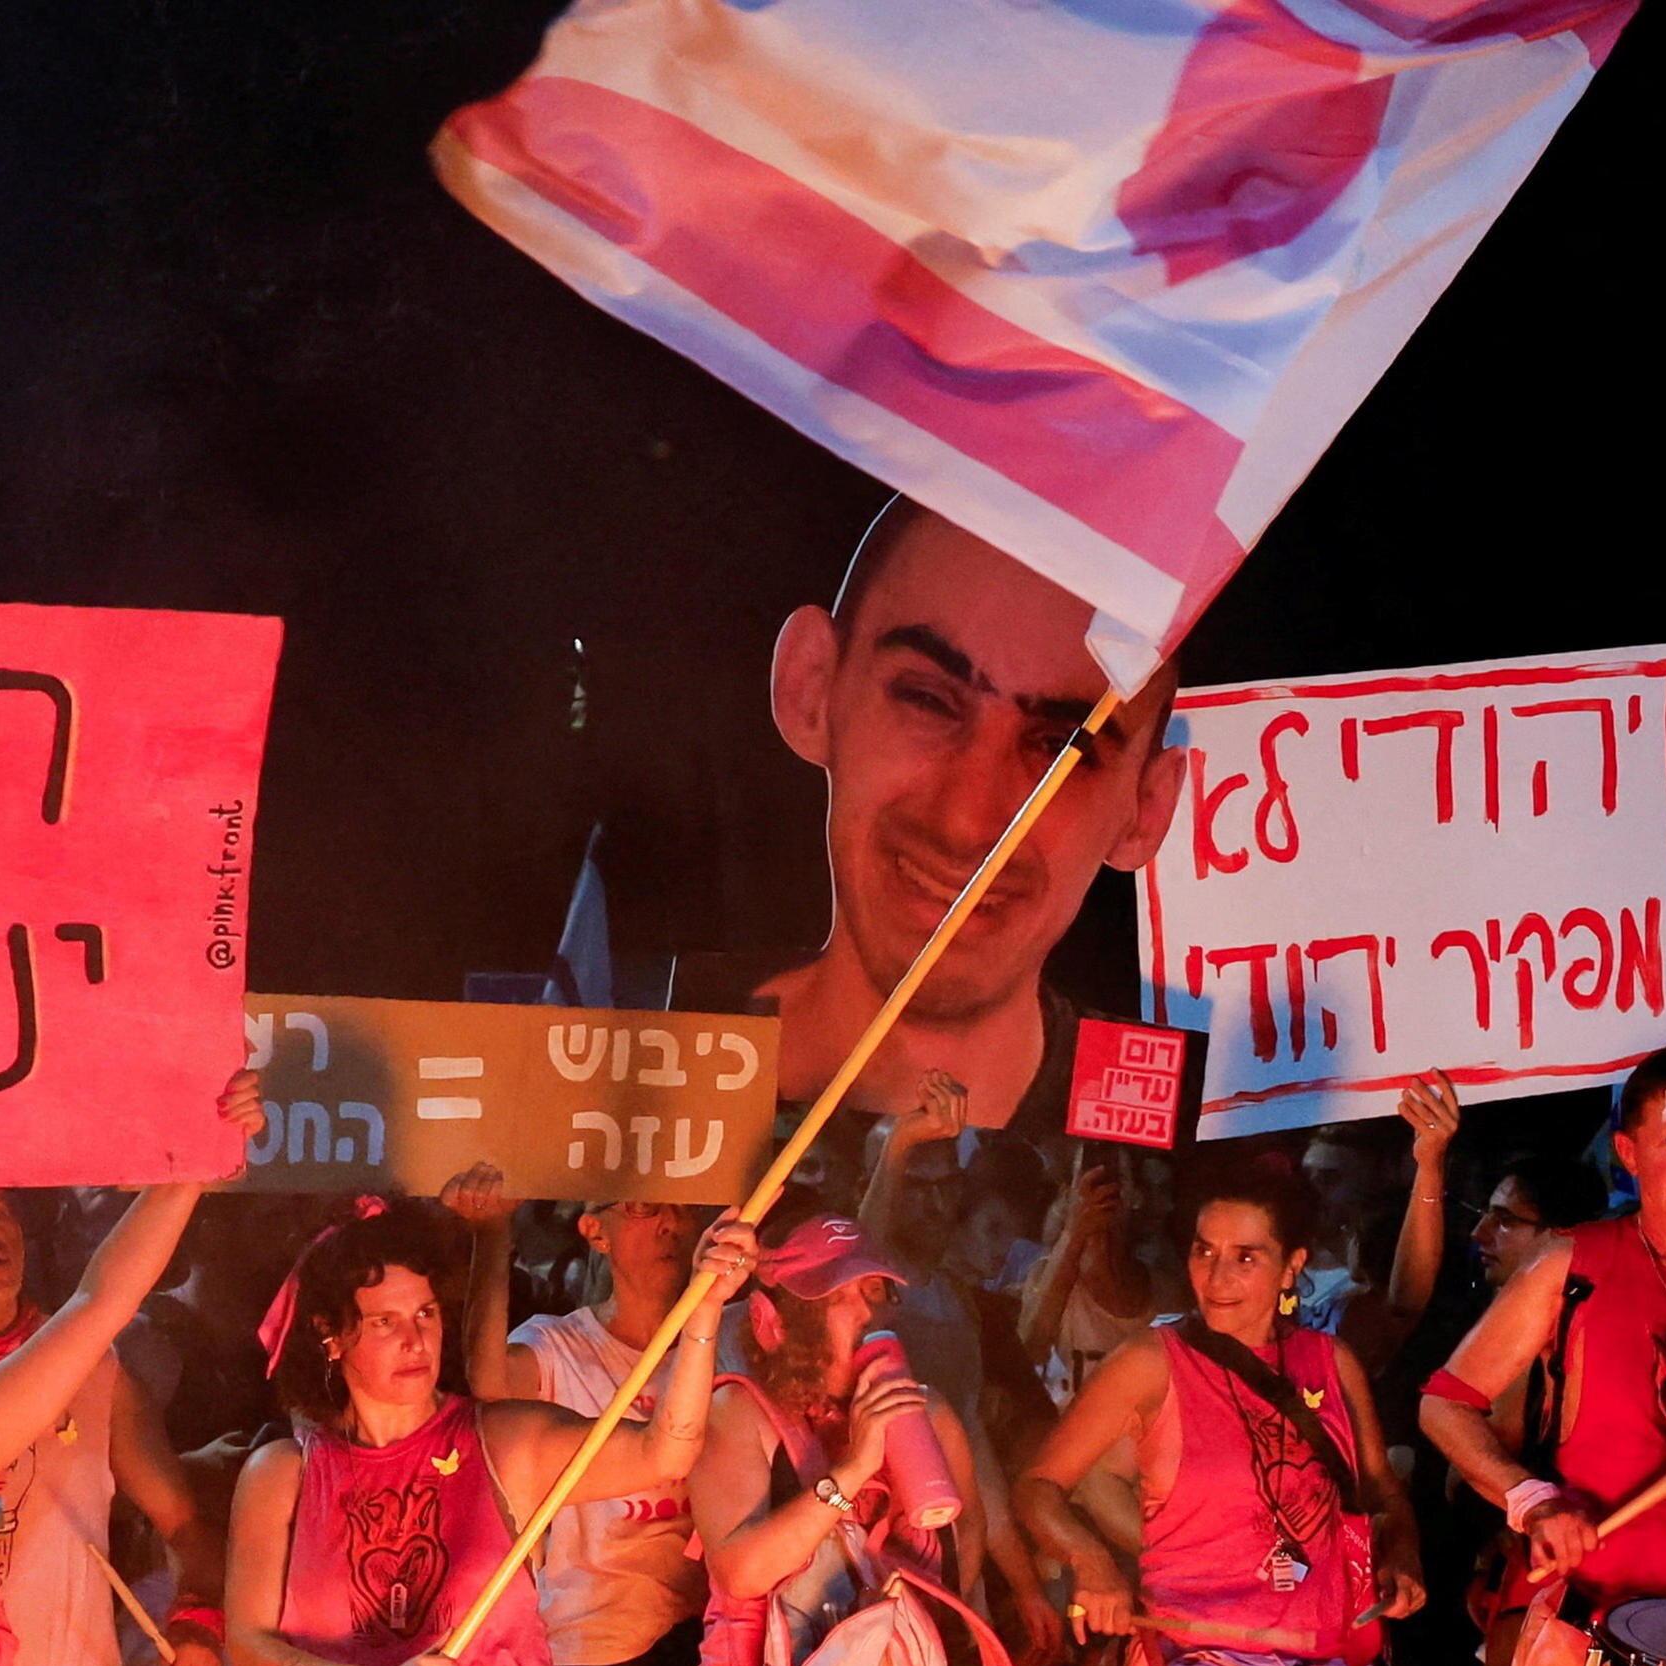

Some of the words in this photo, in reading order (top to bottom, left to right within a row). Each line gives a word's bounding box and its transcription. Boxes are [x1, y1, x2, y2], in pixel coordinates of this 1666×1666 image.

[1188, 710, 1310, 880] לא
[1340, 694, 1643, 833] יהודי
[1185, 934, 1396, 1063] יהודי
[1431, 897, 1665, 1051] מפקיר
[548, 1023, 759, 1092] כיבוש
[1105, 1070, 1173, 1103] עדיין
[1124, 1038, 1176, 1069] רום
[566, 1111, 725, 1178] עזה
